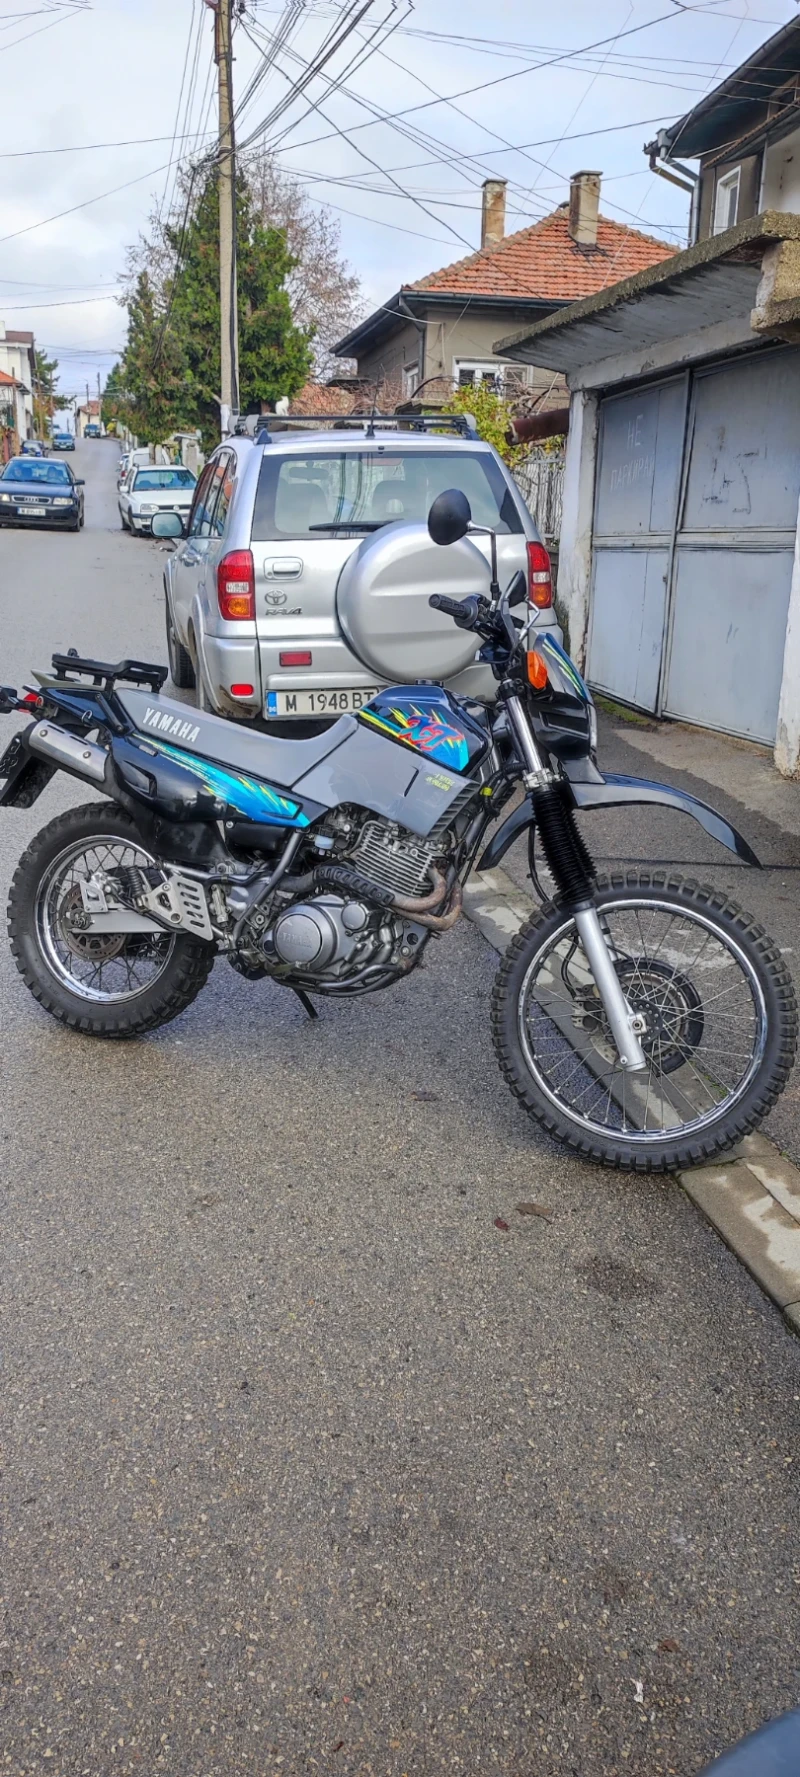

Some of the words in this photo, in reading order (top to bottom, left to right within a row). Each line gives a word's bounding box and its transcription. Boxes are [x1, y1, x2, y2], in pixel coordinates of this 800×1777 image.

[265, 607, 303, 616] RAV4
[285, 694, 298, 712] M
[142, 707, 201, 742] YAMAHA
